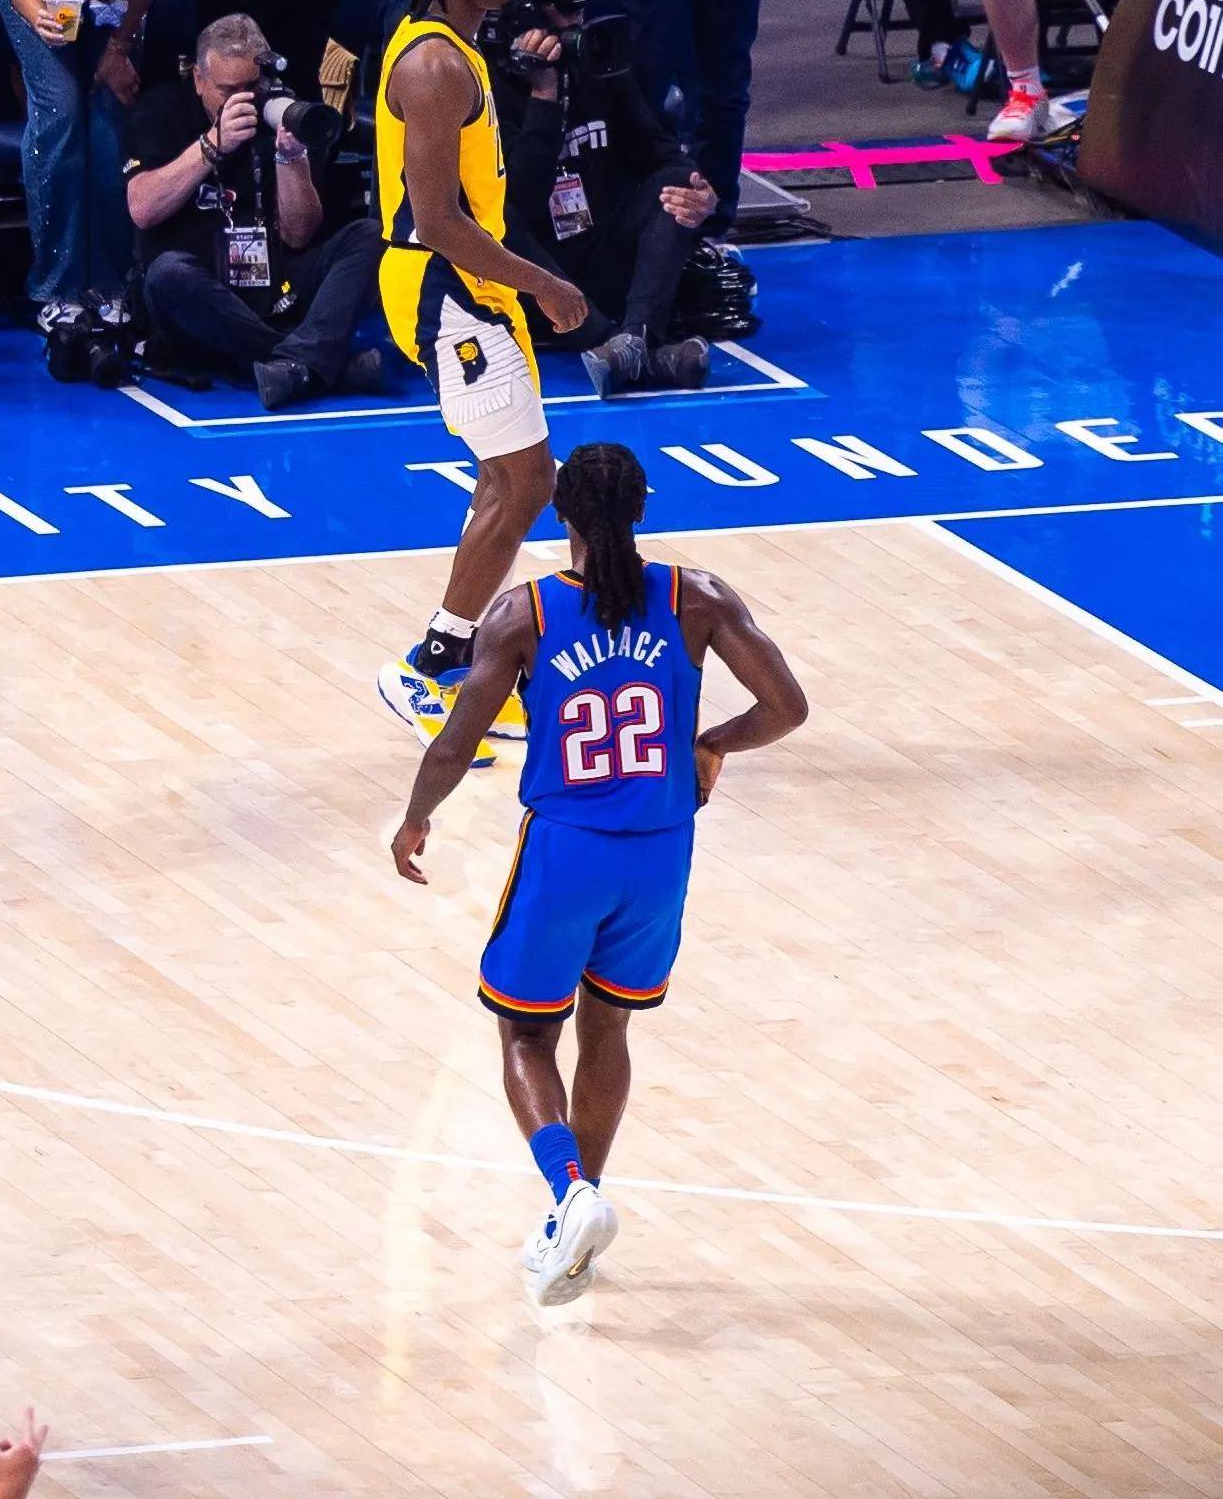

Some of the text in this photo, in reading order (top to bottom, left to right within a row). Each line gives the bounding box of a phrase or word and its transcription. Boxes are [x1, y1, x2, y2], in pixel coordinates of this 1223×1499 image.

[404, 411, 1223, 495] TUNDE
[550, 625, 668, 682] WALLACE
[559, 681, 667, 786] 22
